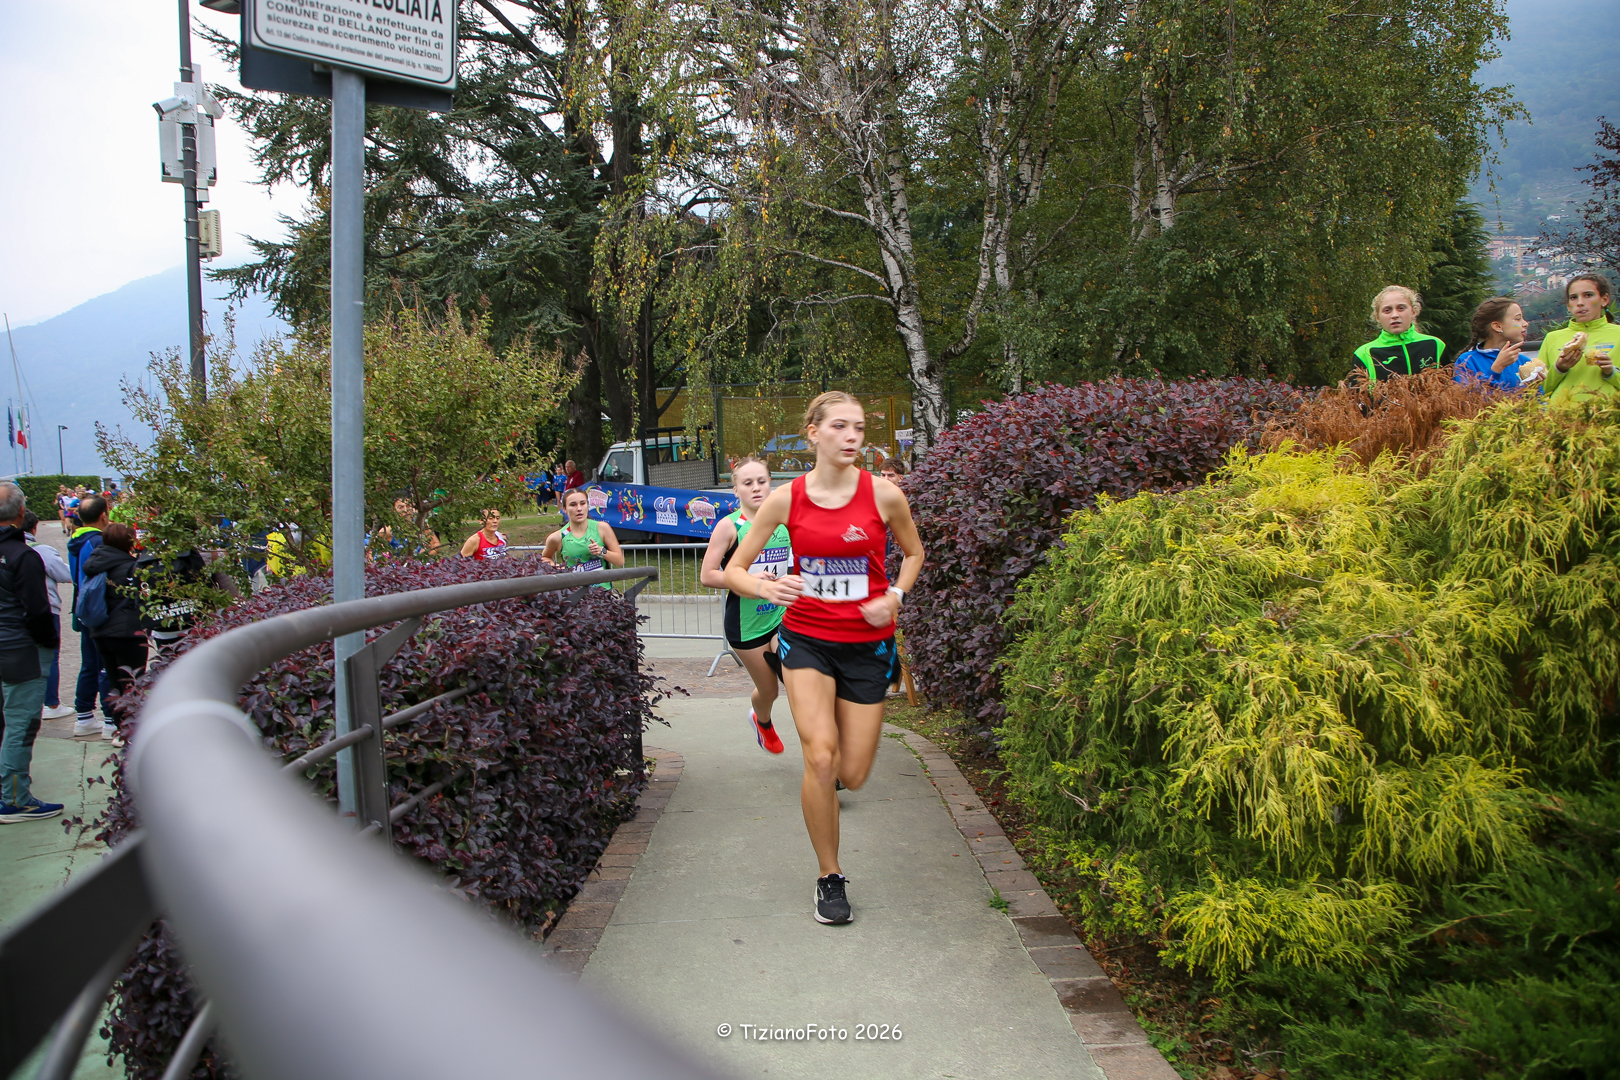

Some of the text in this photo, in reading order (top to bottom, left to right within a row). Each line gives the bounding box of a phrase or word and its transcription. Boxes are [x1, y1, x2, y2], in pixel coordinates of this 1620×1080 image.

[266, 0, 444, 51] COMUNE DI BELLANO per fini di
[267, 13, 444, 61] sicurezza ed accertamento violazioni.
[366, 12, 373, 21] è
[376, 17, 428, 35] effettuata
[431, 30, 444, 40] da
[813, 577, 850, 597] 441
